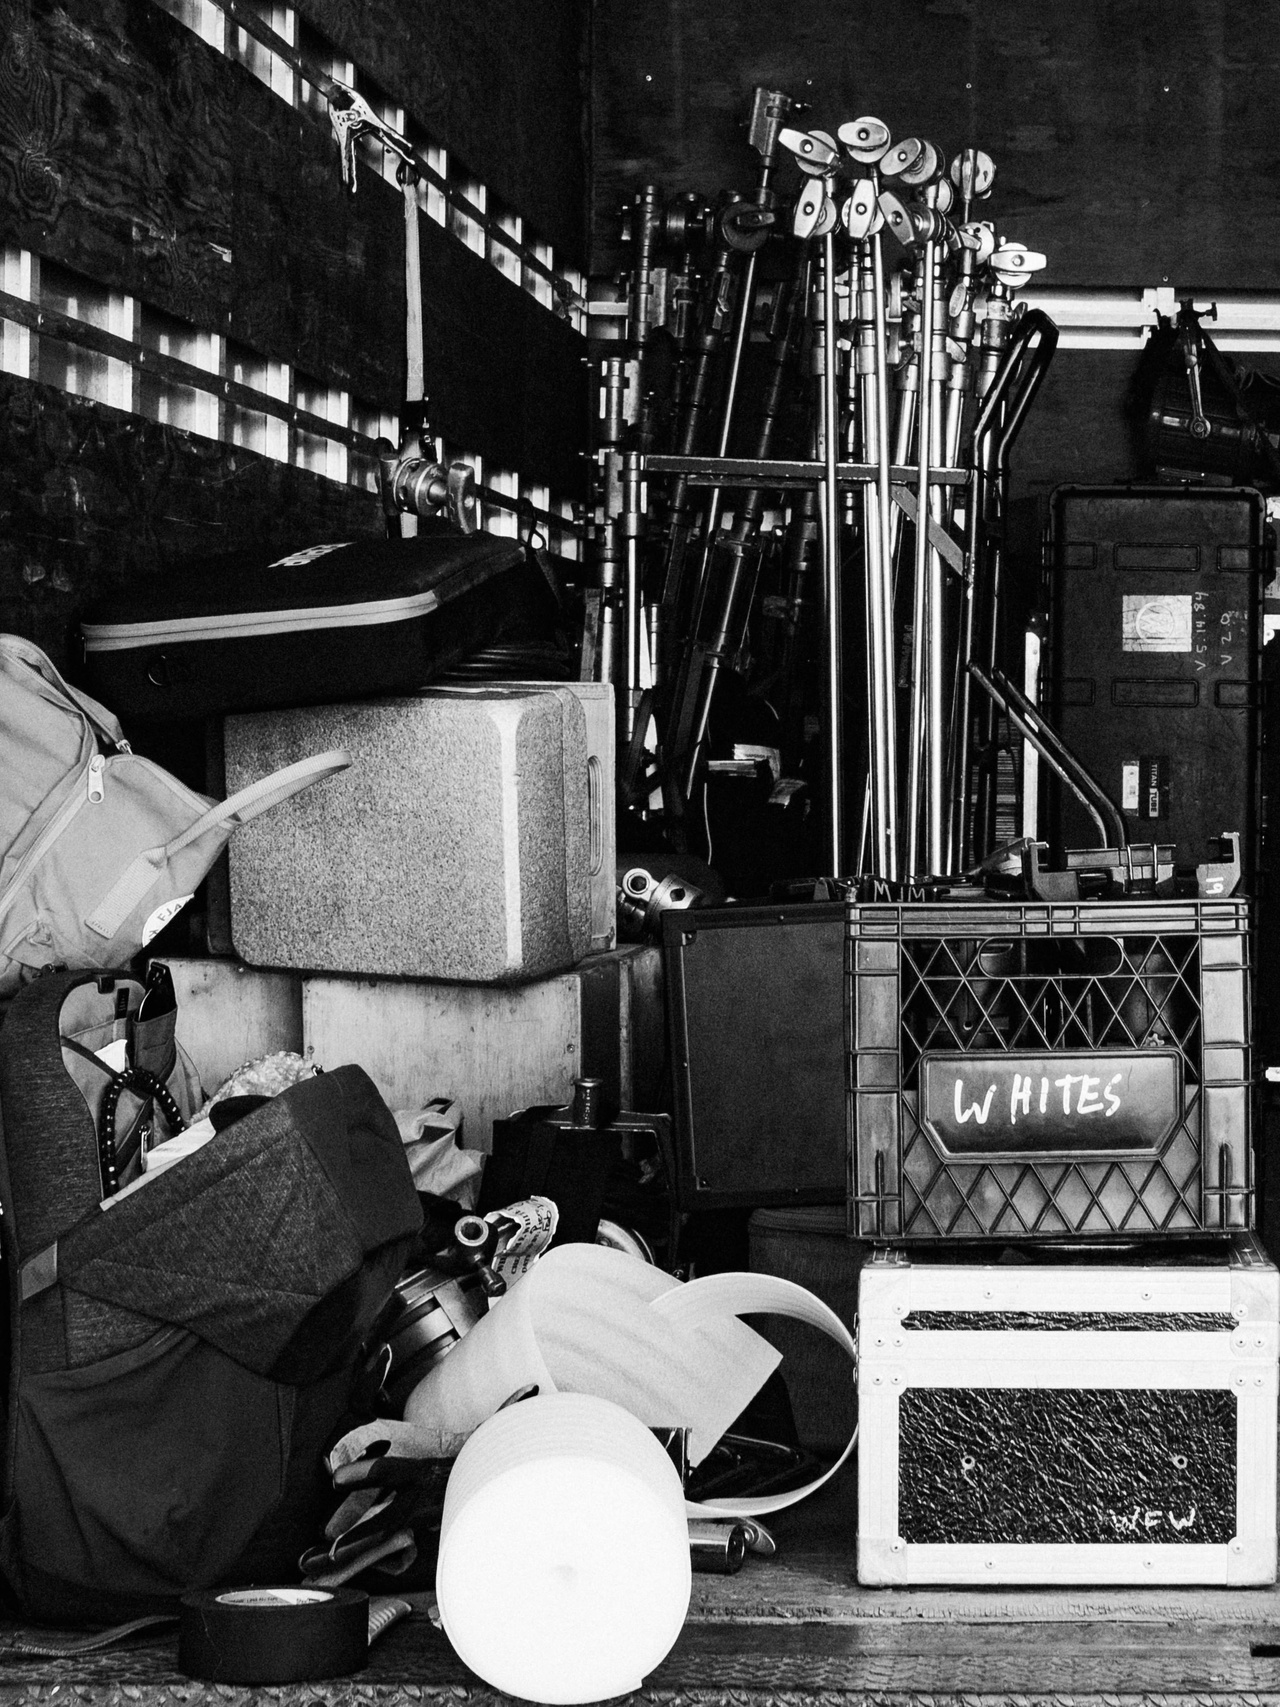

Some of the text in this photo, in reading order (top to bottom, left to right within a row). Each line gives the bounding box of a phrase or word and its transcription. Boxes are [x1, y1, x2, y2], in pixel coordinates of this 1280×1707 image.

[1150, 791, 1158, 812] TUBE
[953, 1072, 1123, 1125] WHITES
[1106, 1504, 1196, 1535] WFW
